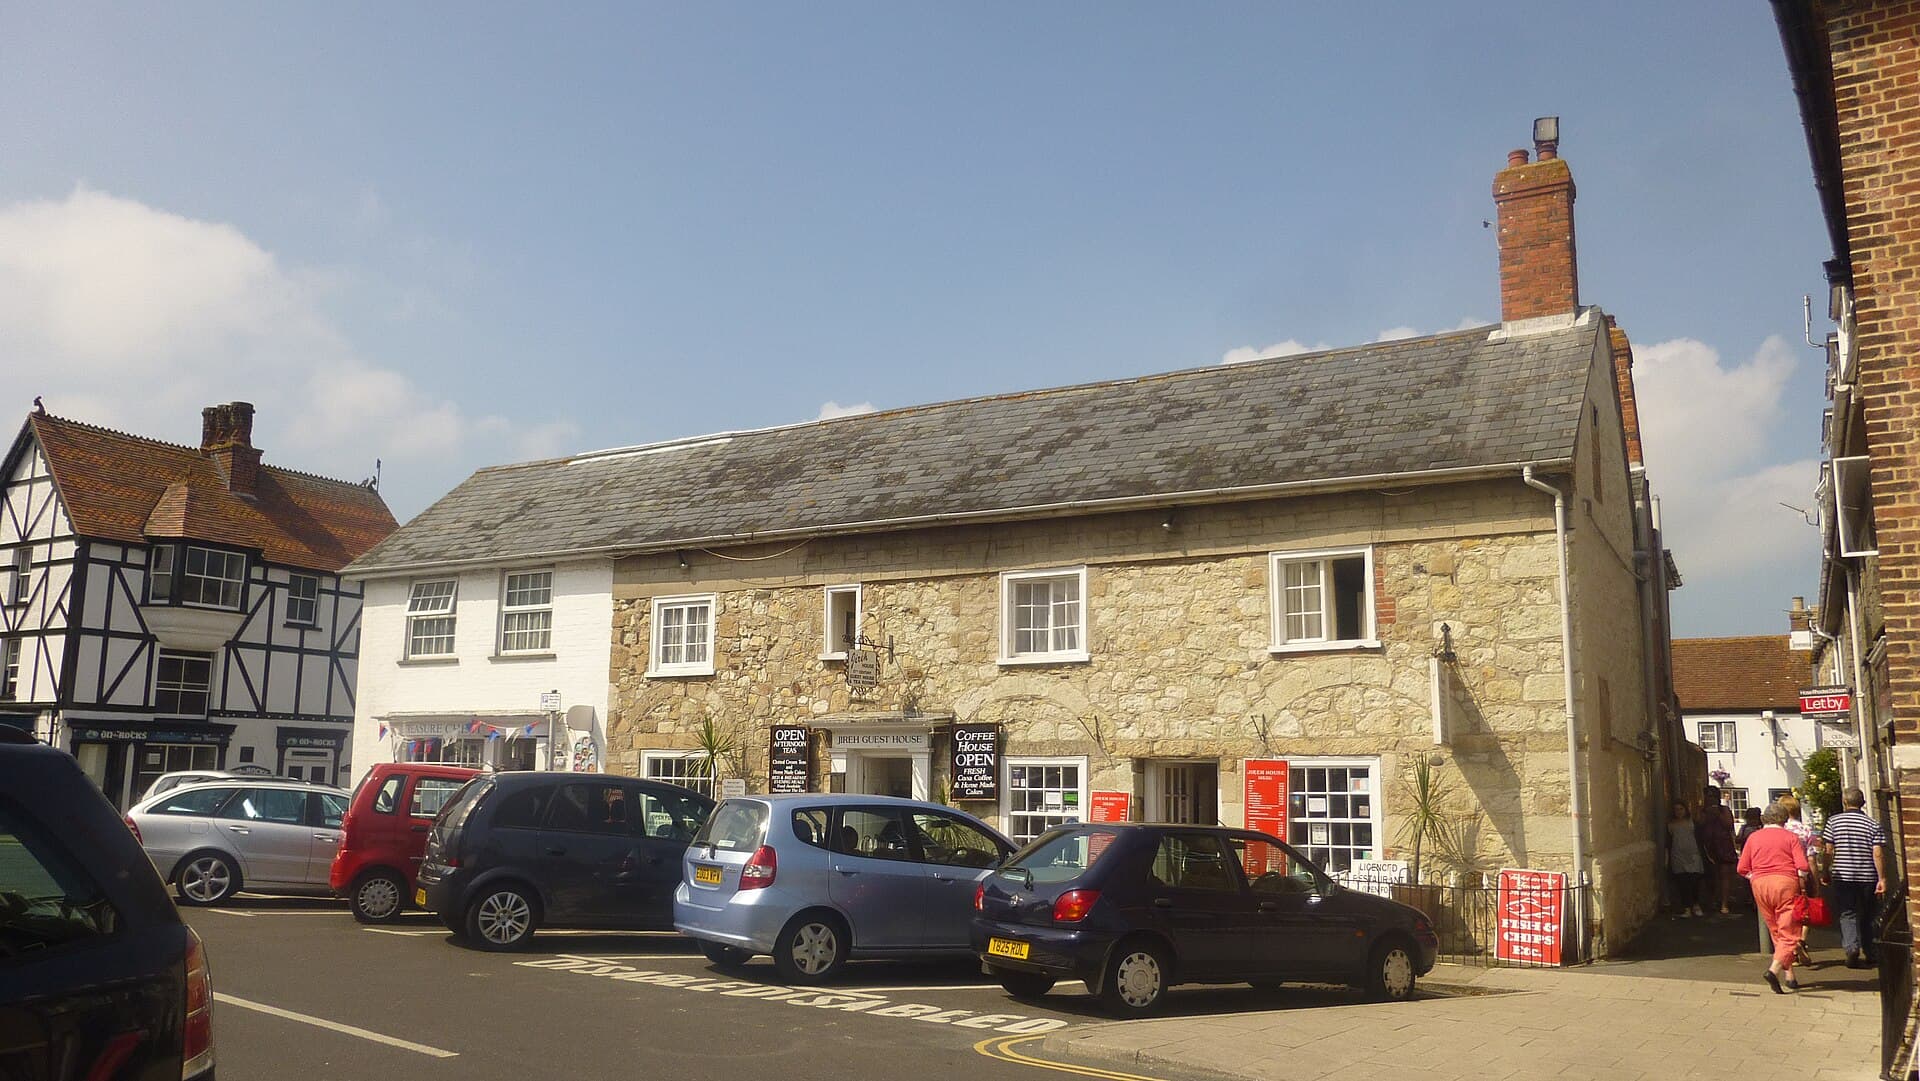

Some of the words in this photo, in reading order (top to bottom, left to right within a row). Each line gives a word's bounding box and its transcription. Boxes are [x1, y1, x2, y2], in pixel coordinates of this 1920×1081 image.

[775, 729, 806, 741] OPEN
[838, 735, 860, 744] JIREH
[861, 735, 890, 744] GUEST
[892, 735, 923, 744] HOUSE
[1823, 739, 1854, 747] BOOKS
[955, 753, 995, 767] OPEN
[963, 767, 986, 775] FRESH
[973, 774, 993, 782] Coffee
[961, 781, 979, 789] Home
[979, 781, 996, 789] Made
[1501, 918, 1542, 931] FISH
[1542, 922, 1559, 932] &
[1503, 931, 1555, 946] CHIPS
